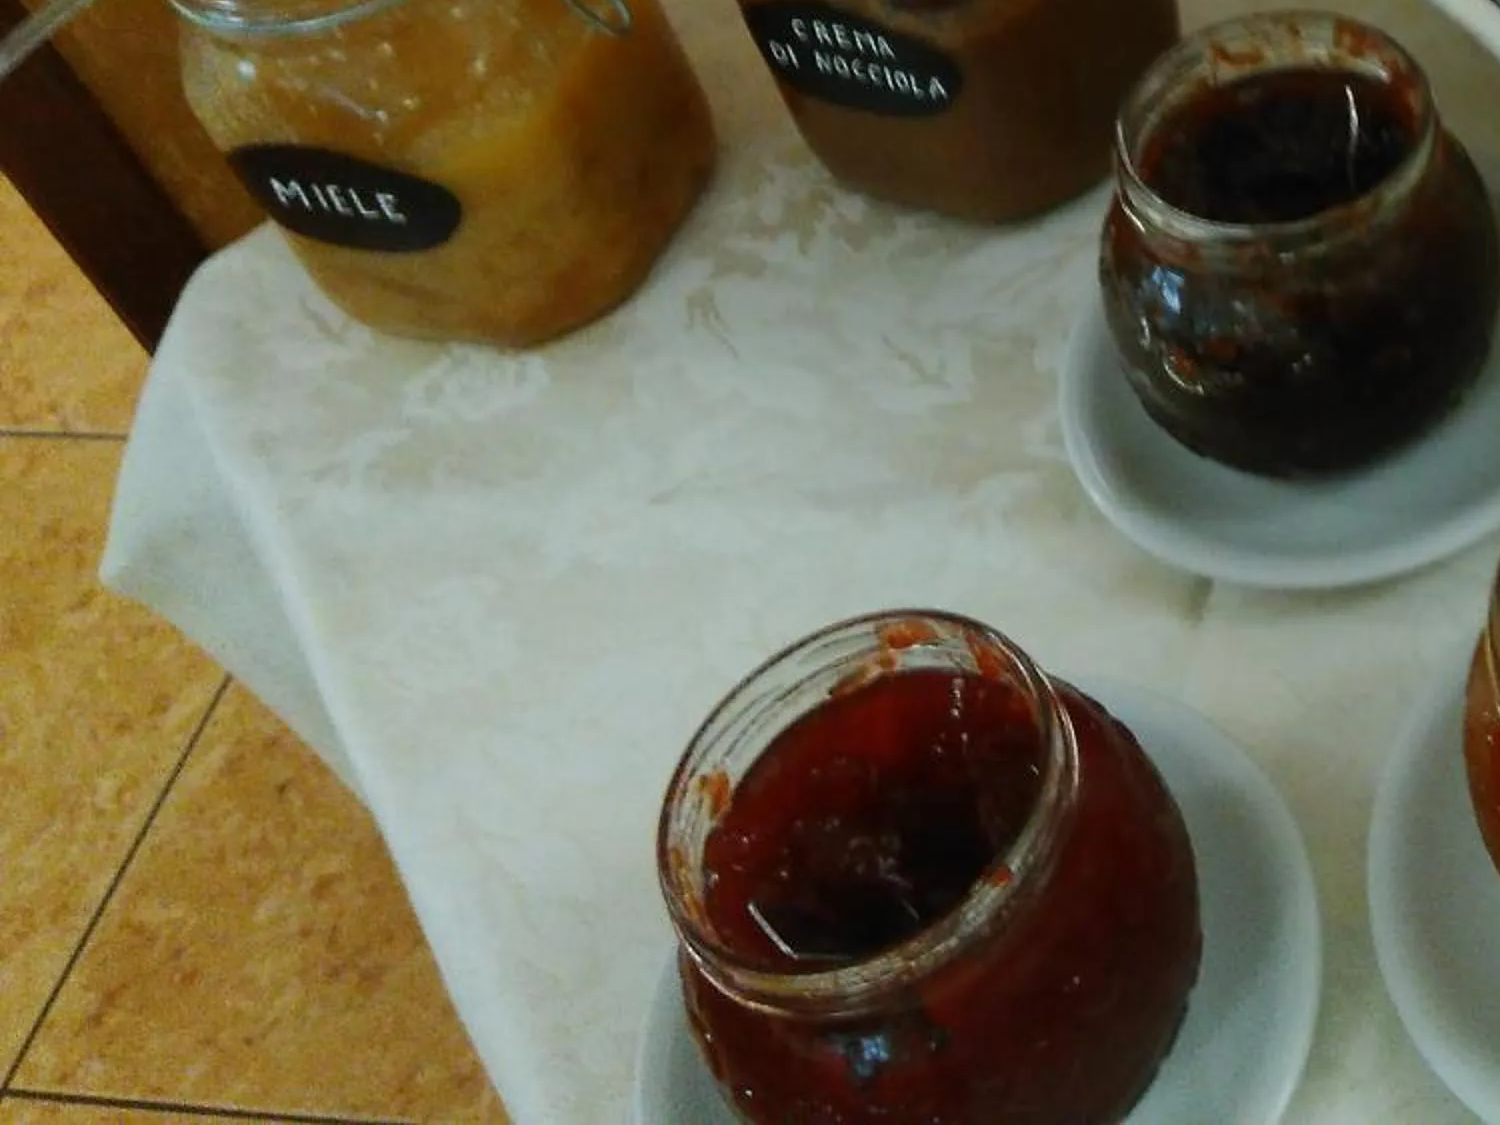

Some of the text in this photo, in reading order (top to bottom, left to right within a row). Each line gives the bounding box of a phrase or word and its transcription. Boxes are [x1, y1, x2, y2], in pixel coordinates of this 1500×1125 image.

[790, 17, 897, 61] CREMA
[768, 39, 949, 101] DI NOCCIOLA
[269, 176, 407, 225] MIELE
